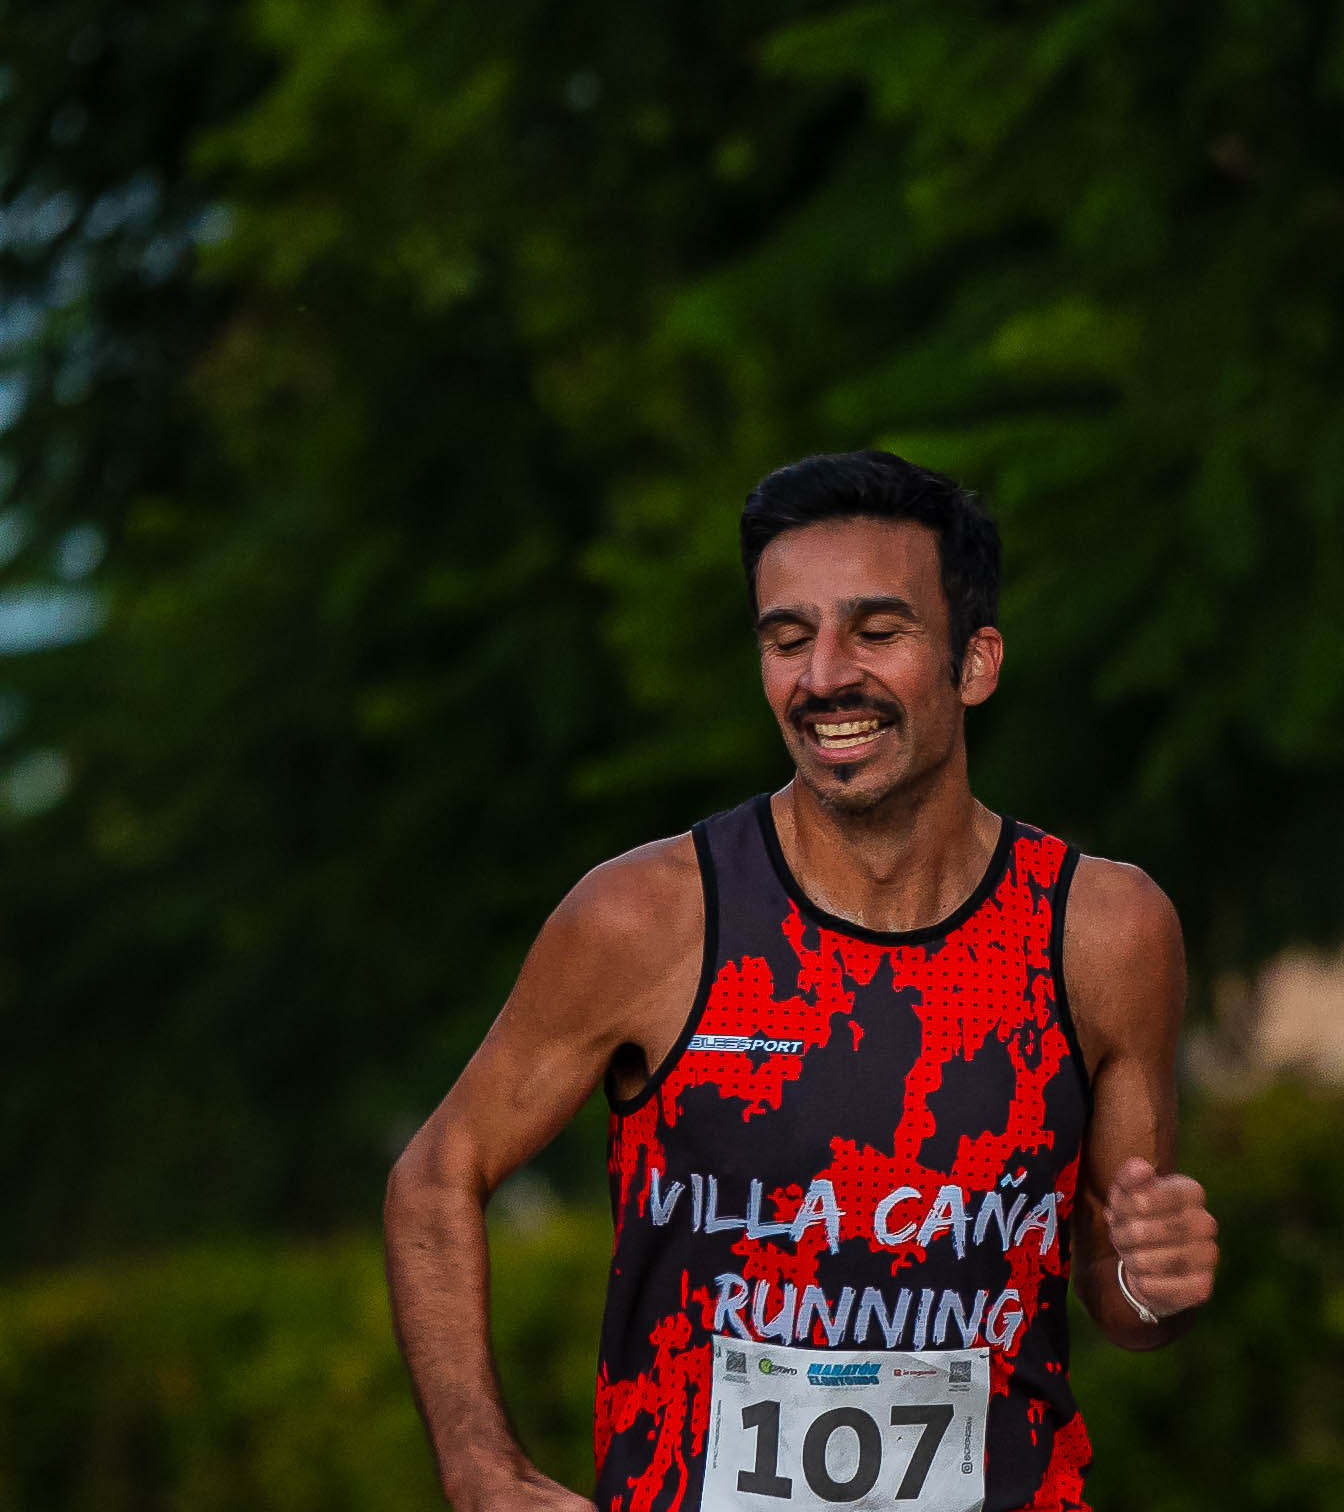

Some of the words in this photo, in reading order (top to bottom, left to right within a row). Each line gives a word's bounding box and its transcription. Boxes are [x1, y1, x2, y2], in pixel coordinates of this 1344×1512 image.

[651, 1168, 847, 1255] VILLA
[874, 1170, 1065, 1260] CAÑA
[714, 1272, 1024, 1352] RUNNING
[735, 1399, 956, 1502] 107
